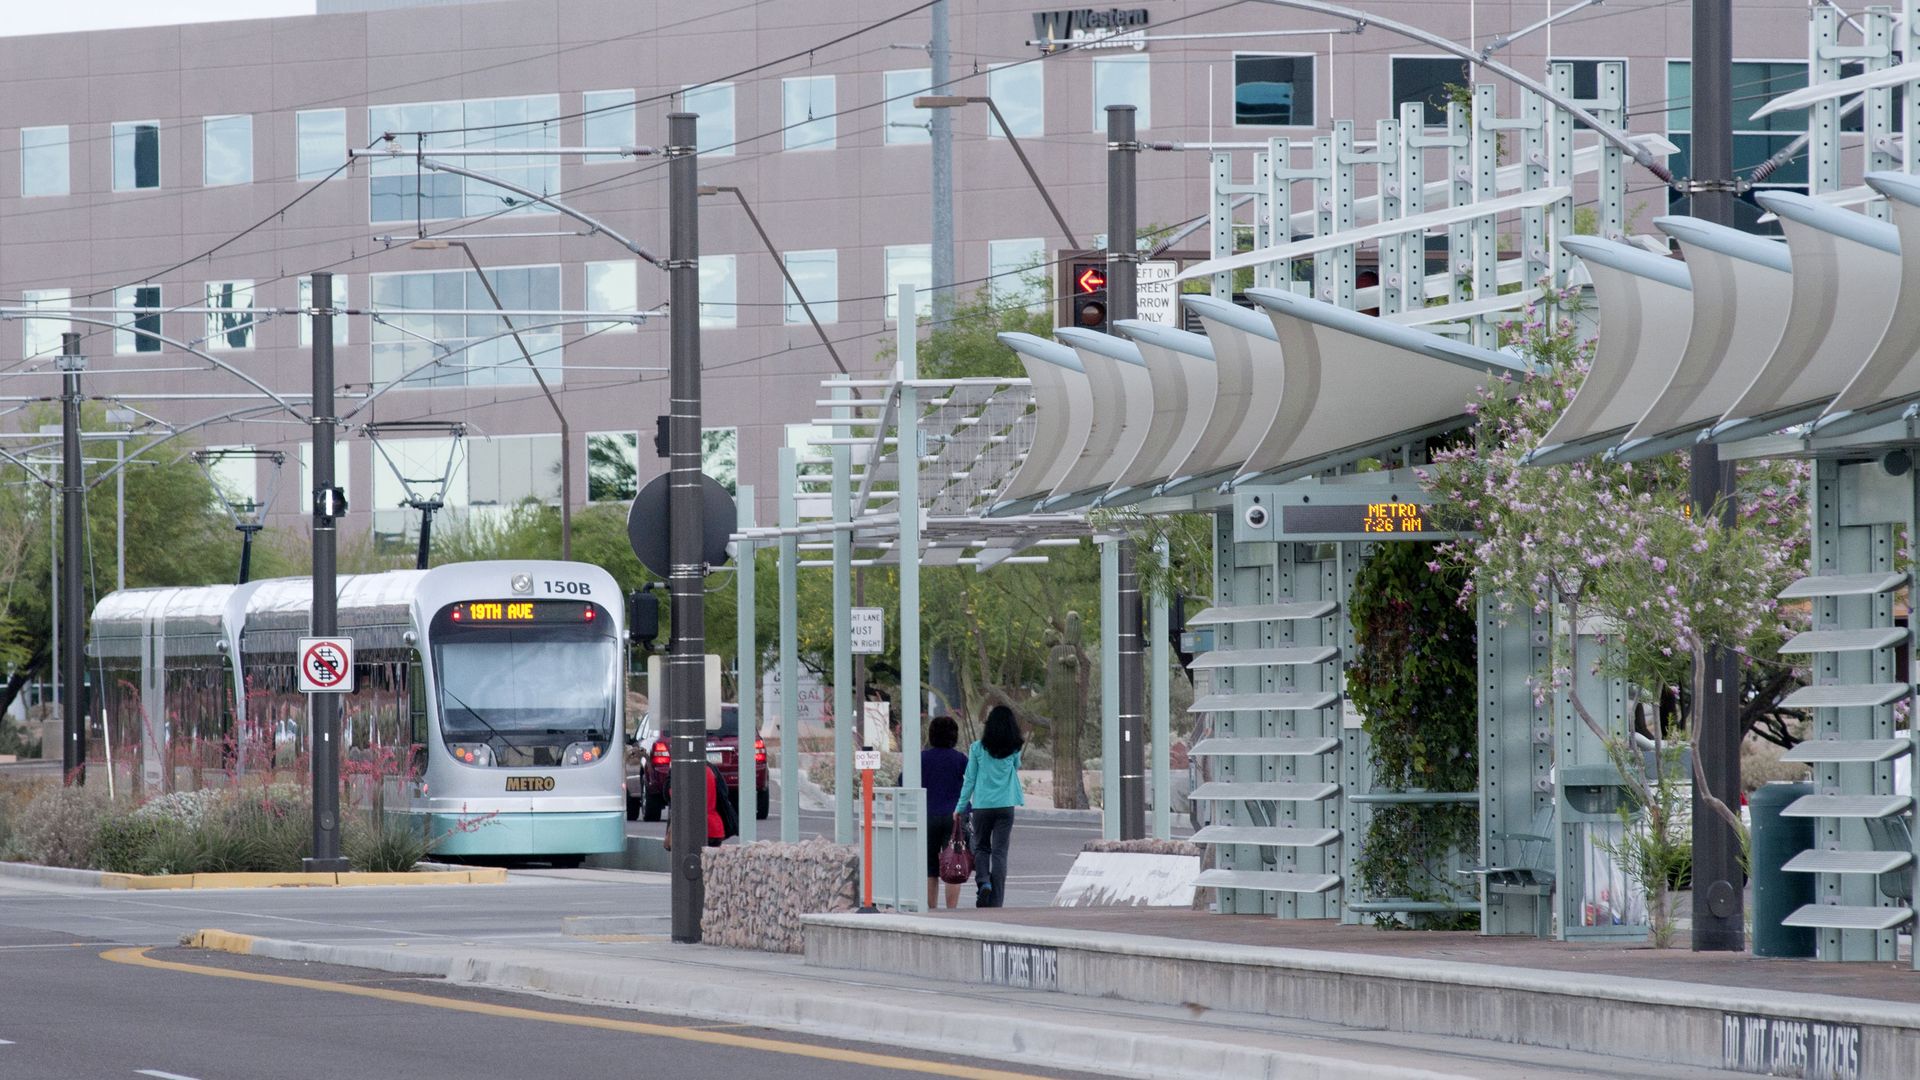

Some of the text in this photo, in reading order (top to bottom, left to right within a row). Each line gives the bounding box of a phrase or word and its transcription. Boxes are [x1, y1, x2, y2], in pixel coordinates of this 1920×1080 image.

[1073, 9, 1147, 28] Western
[1072, 28, 1146, 51] Refining
[1157, 268, 1170, 278] ON
[1139, 312, 1164, 323] ONLY
[1368, 503, 1417, 517] METRO
[1363, 518, 1422, 532] 7:26 AM
[544, 581, 592, 595] 150B
[470, 603, 534, 619] 19TH AVE
[506, 776, 555, 791] METRO
[1725, 1014, 1859, 1080] DO NOT CROSS TRACKS
